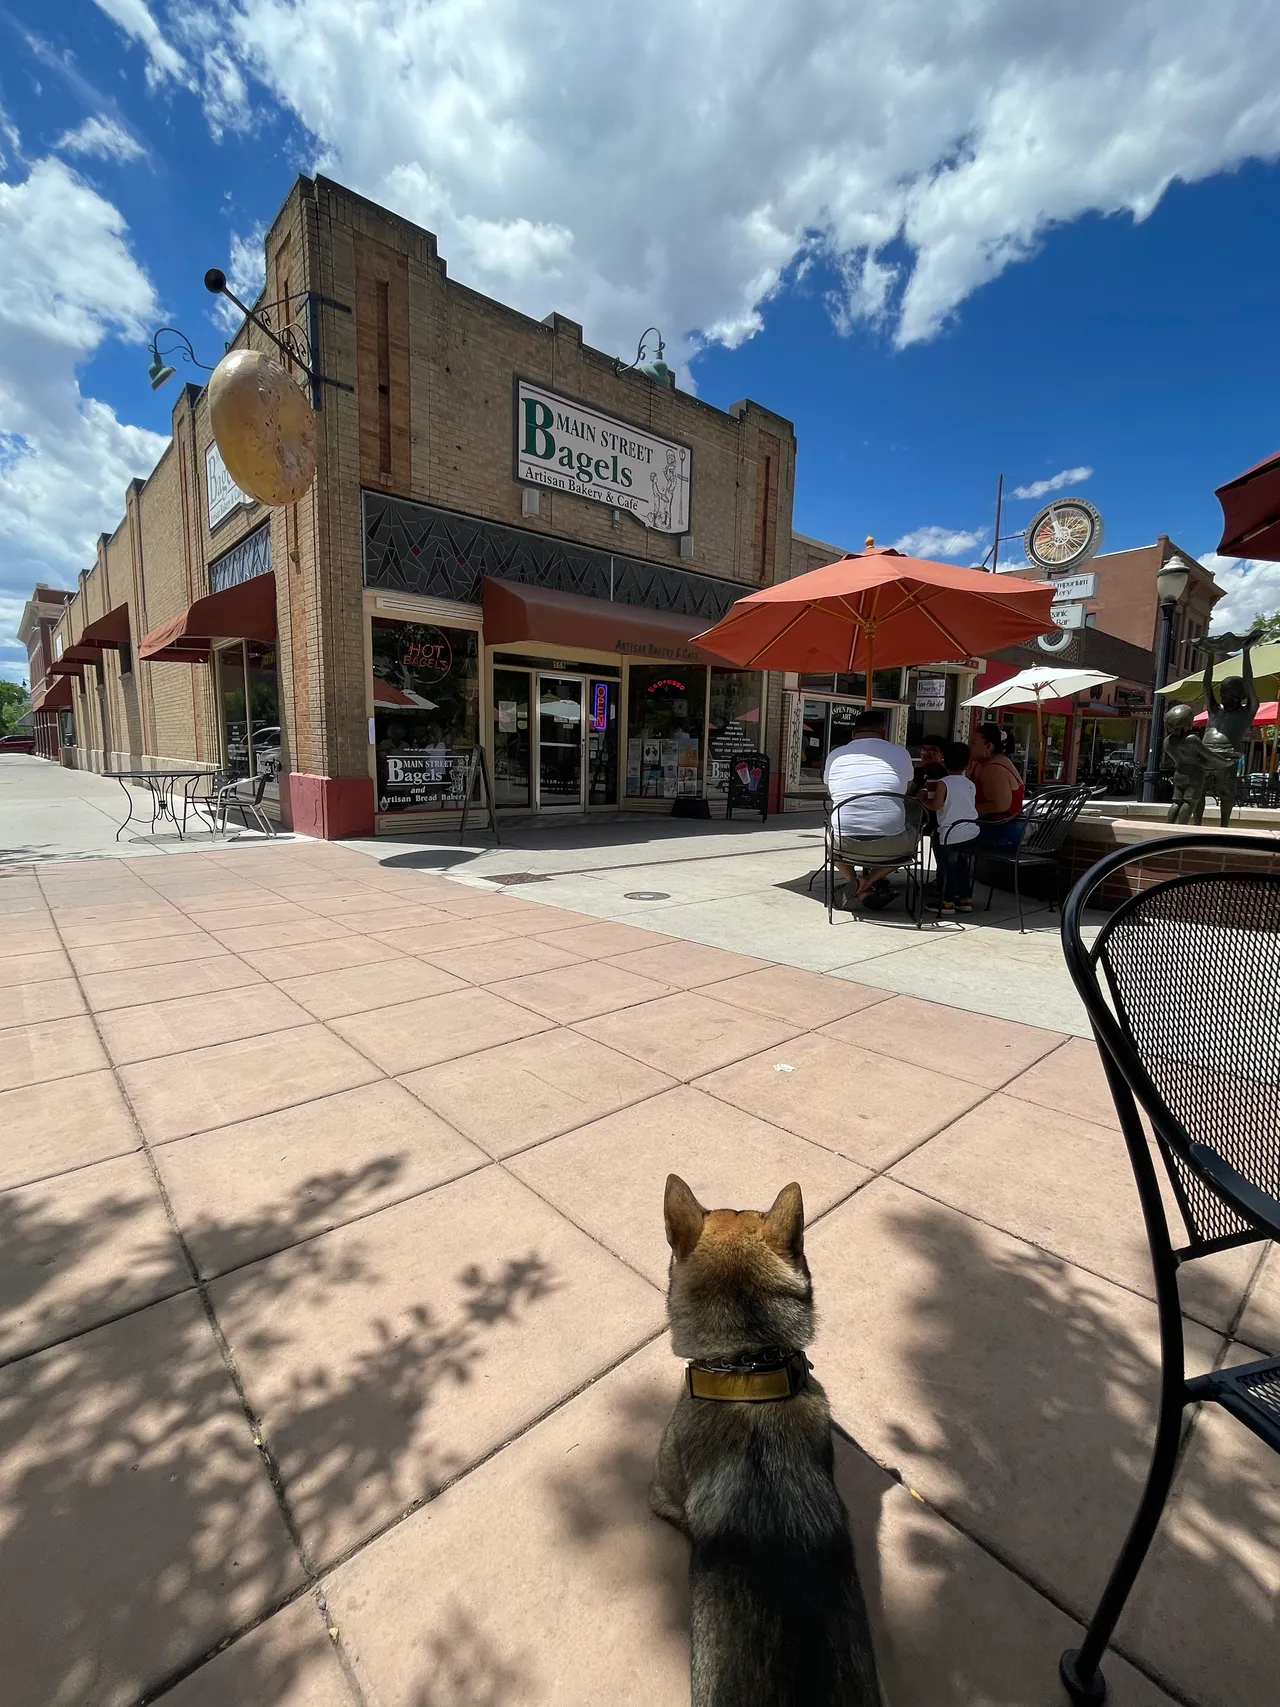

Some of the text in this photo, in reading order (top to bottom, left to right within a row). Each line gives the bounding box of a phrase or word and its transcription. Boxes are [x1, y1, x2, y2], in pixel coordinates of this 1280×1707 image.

[520, 397, 633, 488] Bagels
[556, 413, 654, 464] MAIN STREET
[525, 466, 566, 489] Artisan
[568, 480, 603, 500] Bakery
[605, 491, 615, 504] &
[409, 642, 445, 659] HOT
[403, 655, 449, 671] BAGELS
[647, 679, 686, 693] Espresso
[596, 686, 606, 727] OPEN
[386, 758, 443, 785] Bagels
[403, 760, 454, 768] MAIN STREET
[410, 785, 426, 794] and
[381, 793, 467, 804] Artisan Bread Bakery
